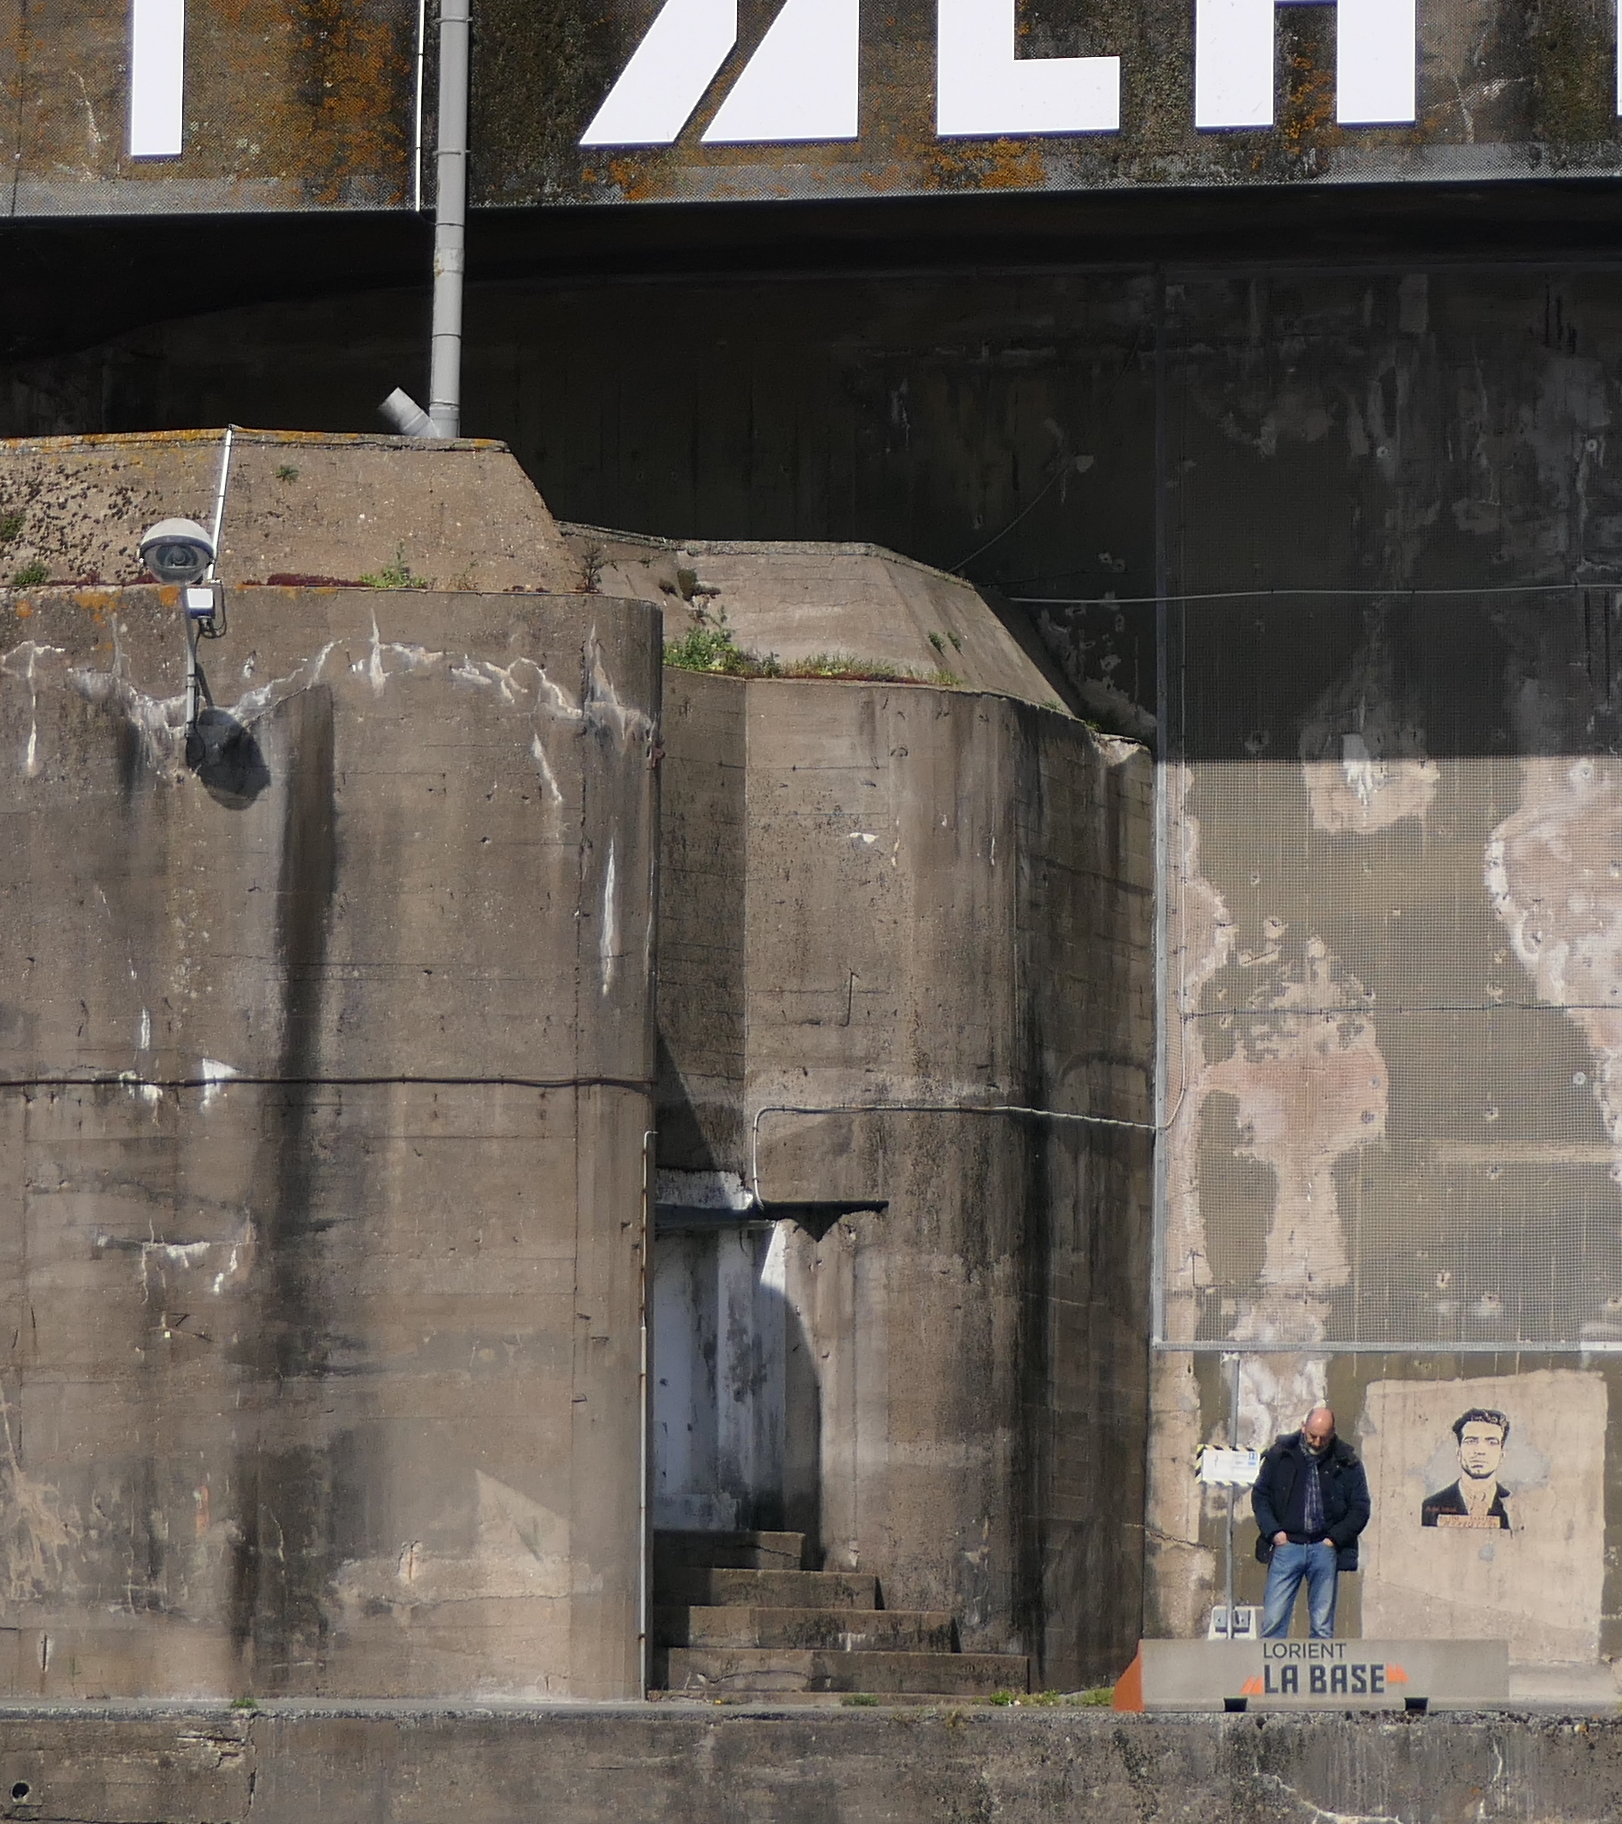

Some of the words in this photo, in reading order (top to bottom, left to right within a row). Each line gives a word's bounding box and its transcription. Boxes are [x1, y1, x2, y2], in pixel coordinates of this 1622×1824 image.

[1263, 1642, 1347, 1659] LORIENT
[1264, 1664, 1298, 1694] LA
[1310, 1664, 1385, 1694] BASE
